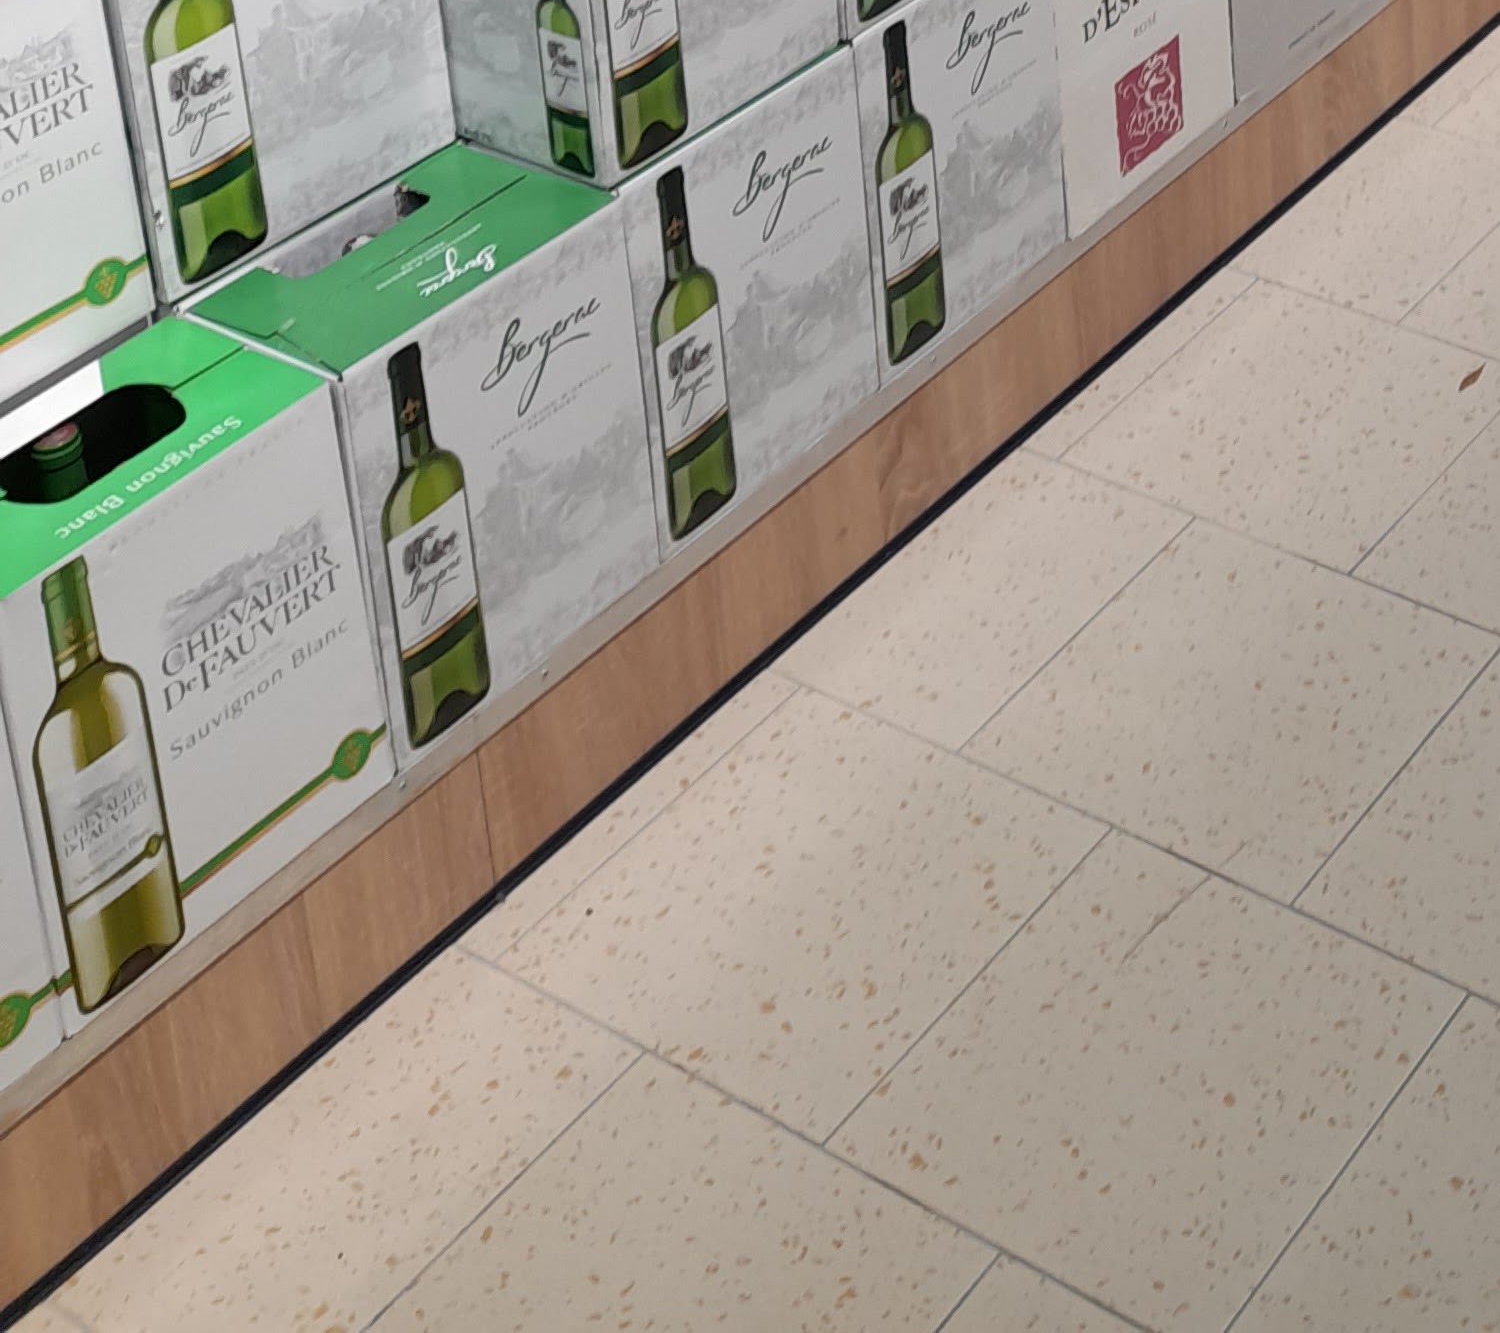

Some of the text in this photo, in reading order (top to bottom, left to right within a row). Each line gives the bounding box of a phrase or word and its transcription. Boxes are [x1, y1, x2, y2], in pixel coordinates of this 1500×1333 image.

[945, 0, 1032, 97] Bergerac
[39, 141, 104, 185] Blanc
[732, 135, 834, 242] Bergerac
[480, 296, 603, 419] Bergerac
[161, 544, 335, 677] CHEVALIER
[168, 617, 350, 762] Sauvignon Blanc
